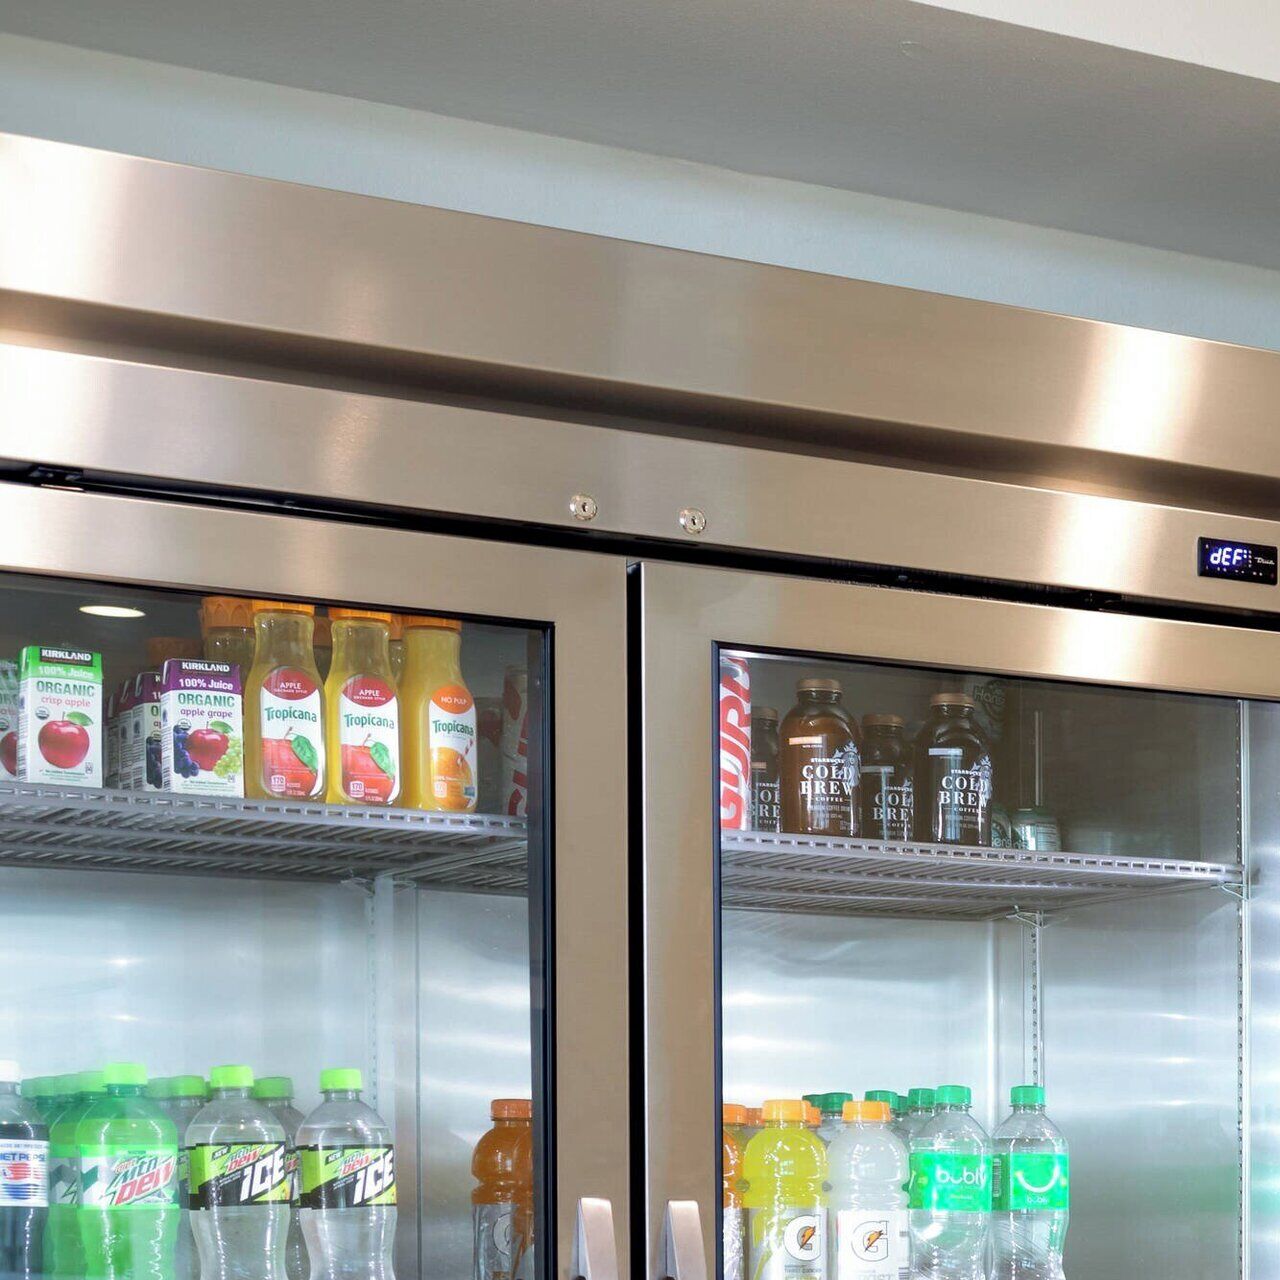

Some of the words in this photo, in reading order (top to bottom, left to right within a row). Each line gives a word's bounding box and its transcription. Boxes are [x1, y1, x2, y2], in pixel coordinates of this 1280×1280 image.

[41, 649, 92, 661] KIRKLAND
[181, 662, 230, 673] KIRKLAND
[36, 680, 95, 697] ORGANIC
[178, 678, 207, 688] 100%
[208, 680, 234, 690] Juice
[279, 682, 302, 690] APPLE
[178, 693, 235, 708] ORGANIC
[359, 689, 380, 697] APPLE
[441, 696, 452, 704] NO
[41, 696, 62, 707] crisp
[65, 697, 91, 708] apple
[180, 709, 205, 719] apple
[207, 710, 233, 720] grape
[264, 705, 317, 722] Tropicana
[344, 713, 395, 729] Tropicana
[432, 719, 474, 737] Tropicana
[802, 764, 852, 779] COLD
[801, 780, 854, 795] BREW
[240, 1145, 285, 1201] ICE
[353, 1152, 393, 1204] ICE
[936, 1165, 986, 1189] bubly
